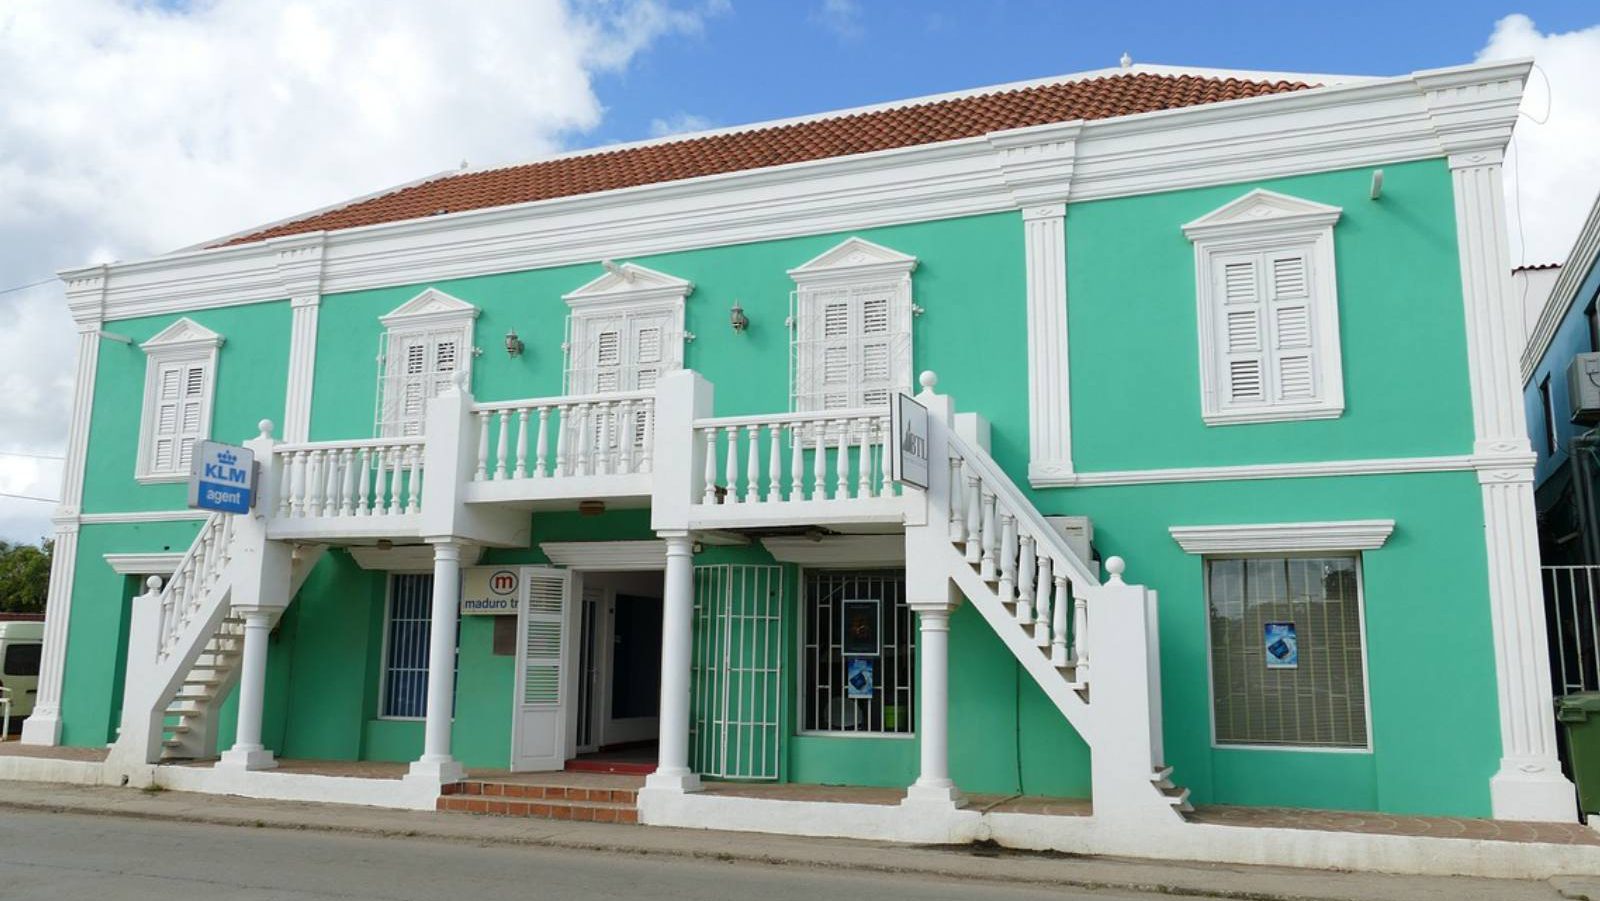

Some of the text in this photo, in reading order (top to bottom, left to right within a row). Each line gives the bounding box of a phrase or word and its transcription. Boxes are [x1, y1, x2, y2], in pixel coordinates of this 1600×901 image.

[205, 463, 246, 483] KLM
[207, 489, 241, 505] agent
[495, 576, 513, 589] m
[465, 598, 507, 609] maduro
